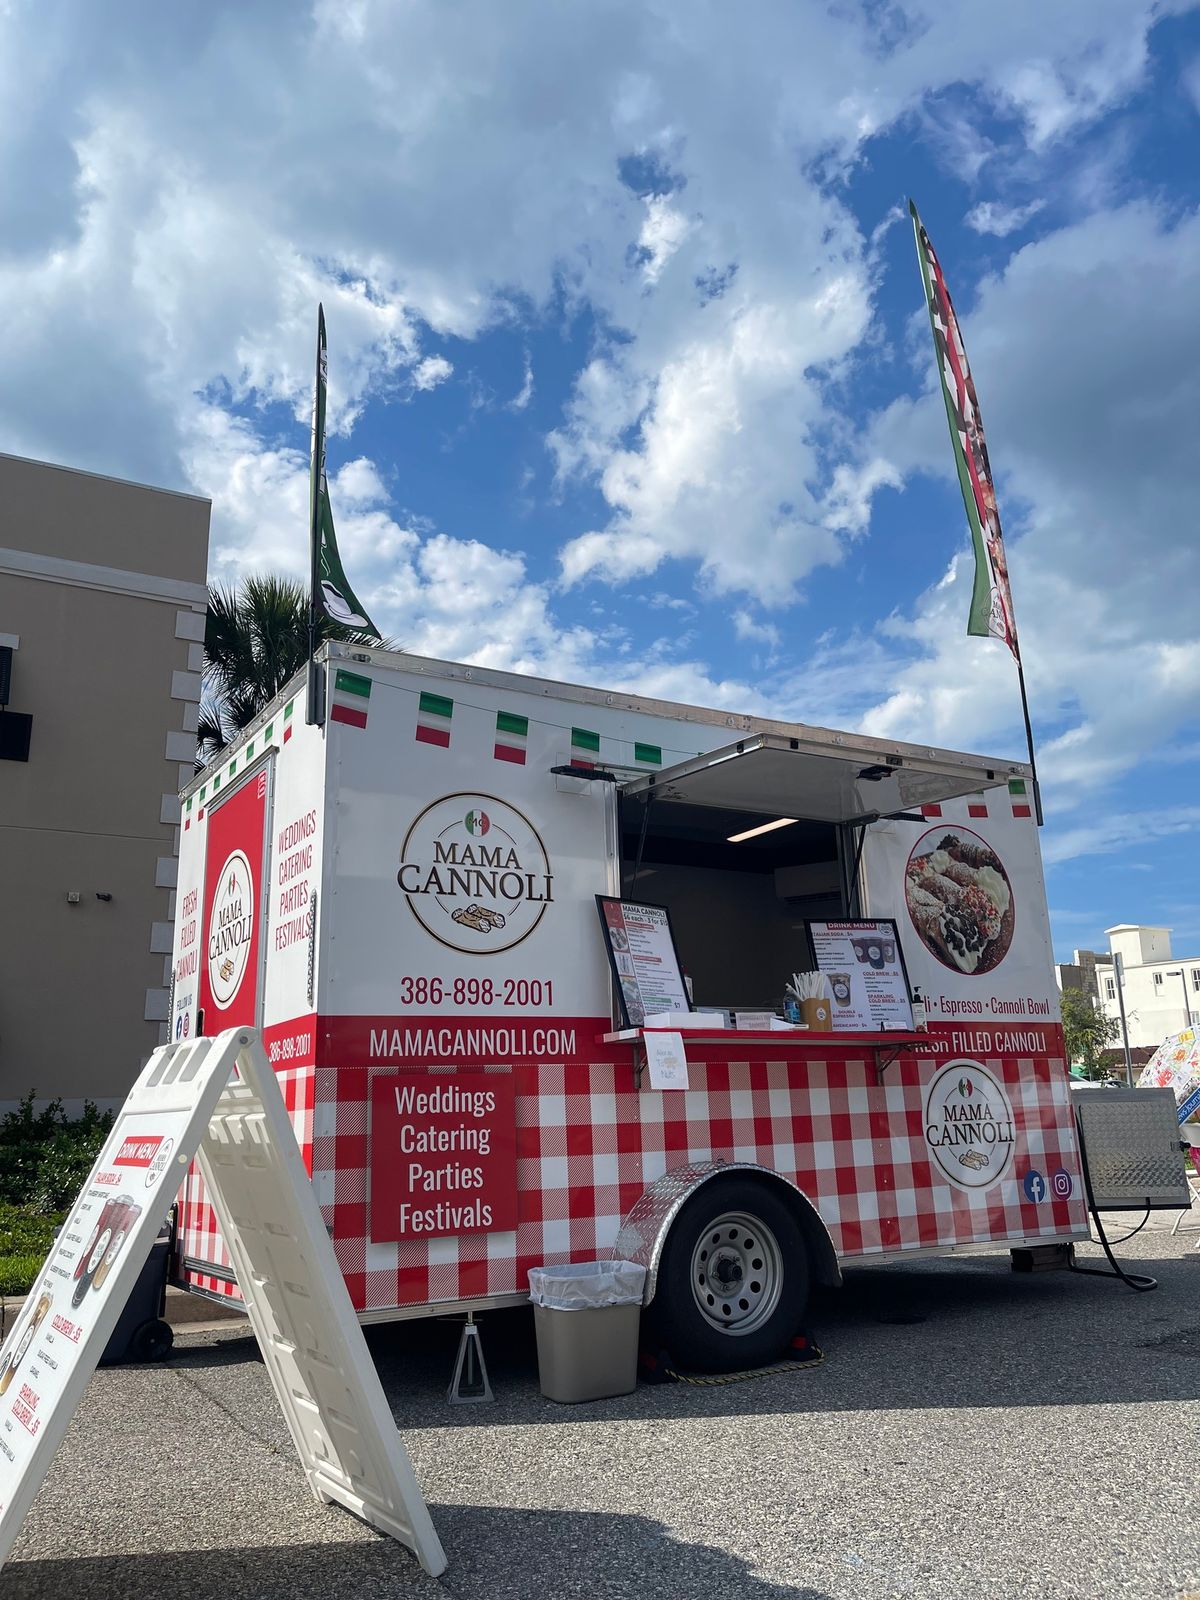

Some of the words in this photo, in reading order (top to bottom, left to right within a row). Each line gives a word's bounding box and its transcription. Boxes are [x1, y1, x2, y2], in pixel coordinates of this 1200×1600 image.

[278, 810, 316, 854] WEDDINGS
[278, 844, 312, 886] CATERING
[433, 841, 522, 870] MAMA
[397, 864, 554, 902] CANNOLI
[182, 888, 198, 920] FRESH
[280, 880, 308, 917] PARTIES
[623, 905, 640, 914] MAMA
[641, 908, 665, 917] CANNOLI
[218, 898, 242, 930] MAMA
[180, 920, 196, 950] FILLED
[210, 914, 252, 960] CANNOLI
[276, 912, 310, 952] FESTIVALS
[176, 949, 198, 982] CANNOLI
[400, 976, 553, 1006] 386-898-2001
[941, 996, 982, 1016] Espresso
[991, 997, 1025, 1015] Cannoli
[1028, 998, 1049, 1015] Bowl
[269, 1033, 310, 1062] 386-898-2001
[370, 1028, 576, 1057] MAMACANNOLI.COM
[952, 1032, 992, 1053] FILLED
[996, 1032, 1046, 1052] CANNOLI
[395, 1086, 495, 1117] Weddings
[943, 1104, 994, 1122] MAMA
[400, 1124, 490, 1154] Catering
[926, 1122, 1014, 1147] CANNOLI
[118, 1143, 138, 1159] DRINK
[136, 1143, 159, 1160] MENU
[409, 1162, 483, 1192] Parties
[400, 1199, 492, 1233] Festivals
